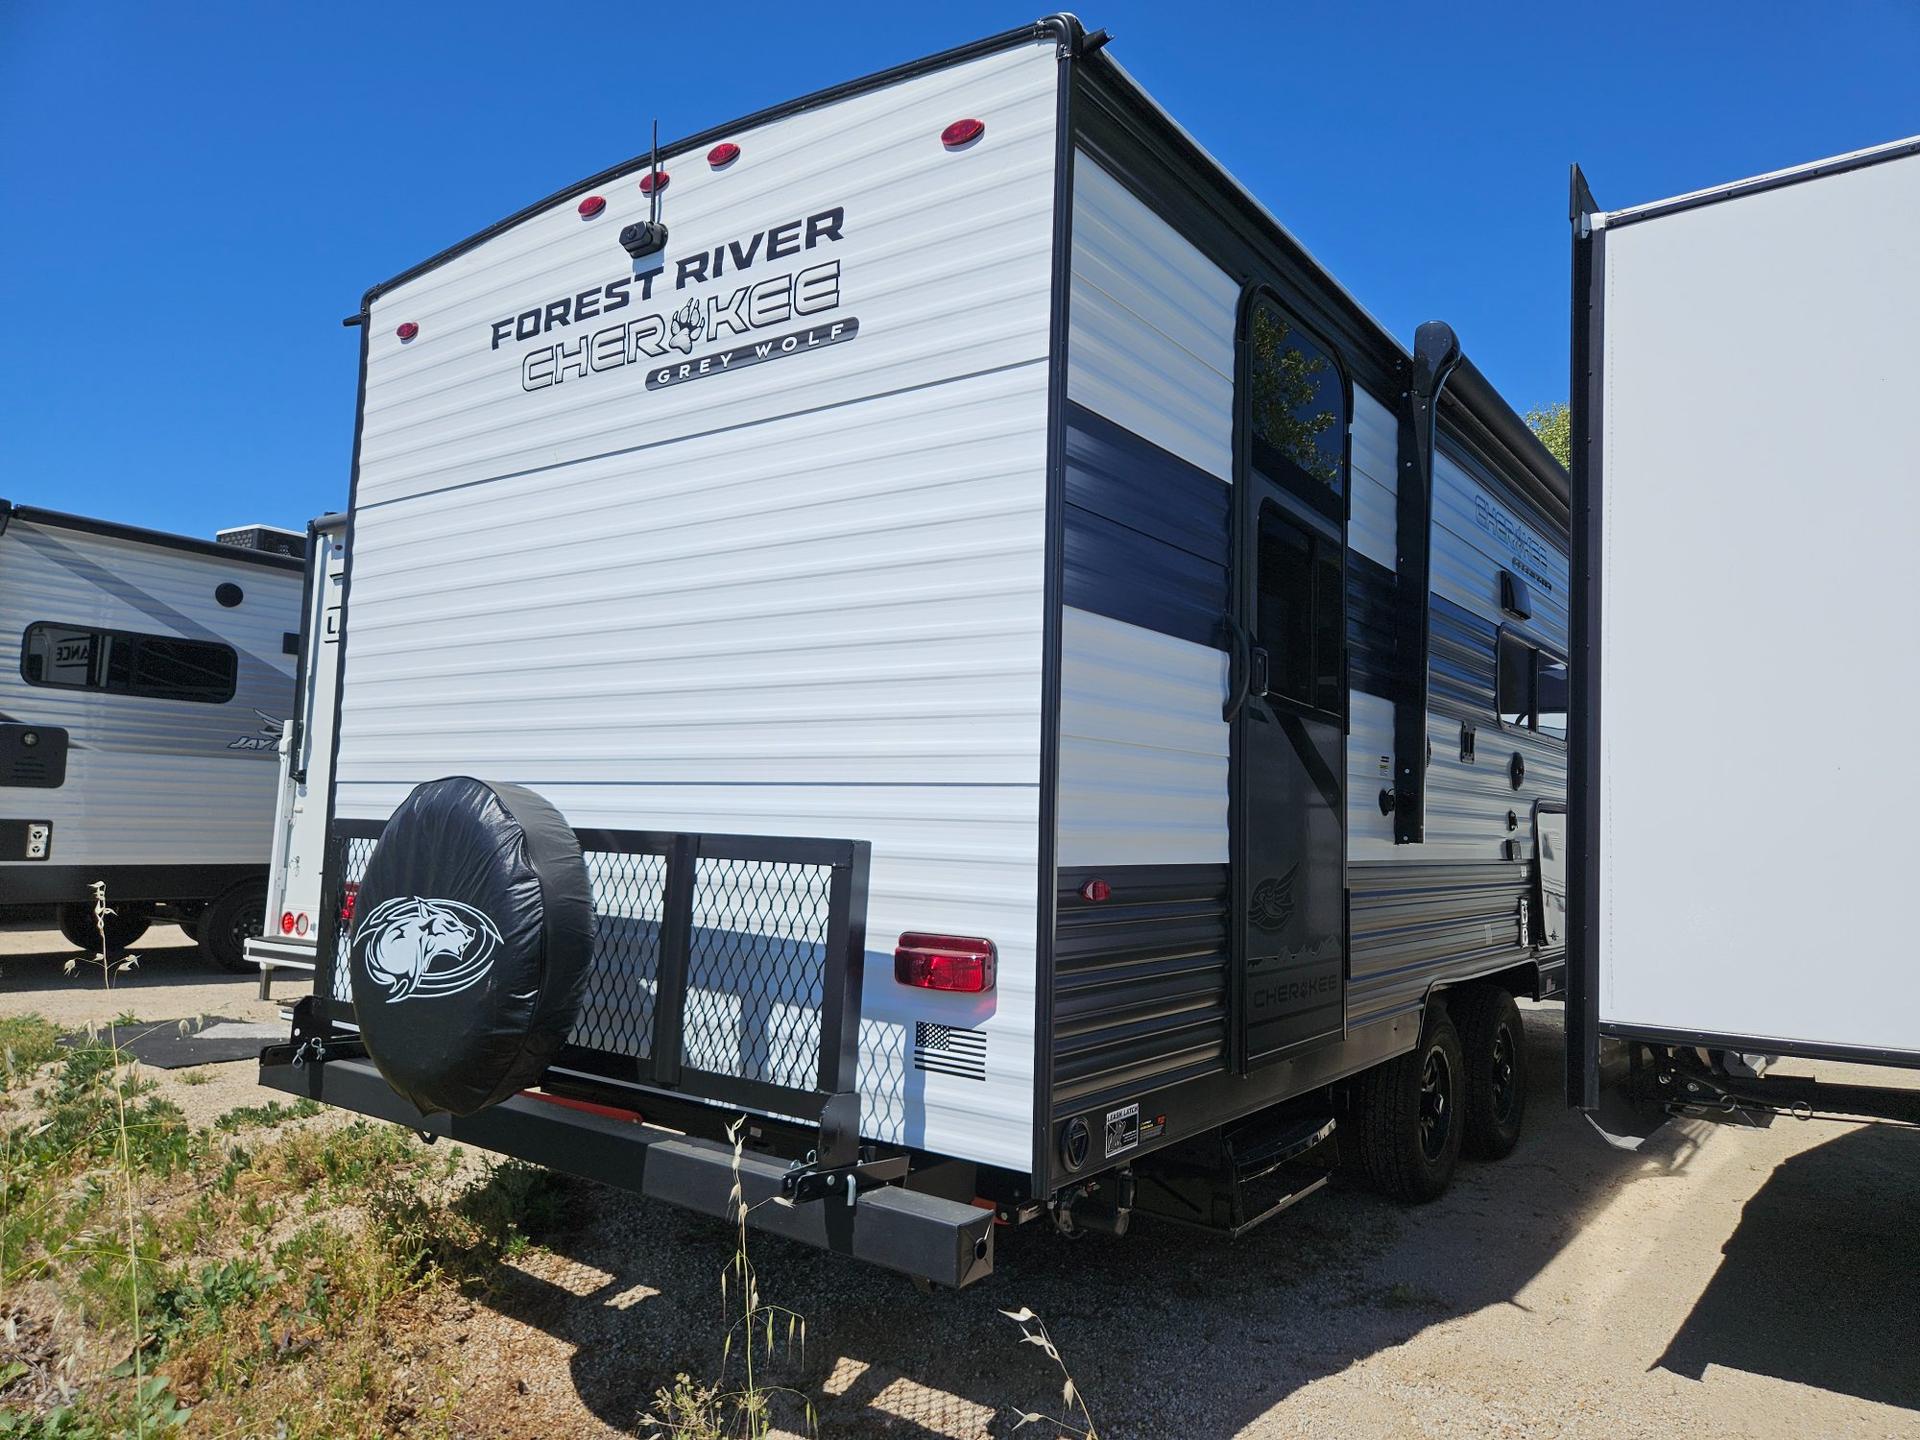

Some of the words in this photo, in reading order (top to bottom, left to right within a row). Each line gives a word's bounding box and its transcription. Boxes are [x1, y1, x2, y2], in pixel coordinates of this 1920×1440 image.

[491, 266, 664, 350] FOREST
[675, 206, 844, 290] RIVER
[657, 354, 734, 384] GREY
[755, 322, 845, 358] WOLF
[227, 736, 274, 750] JAY
